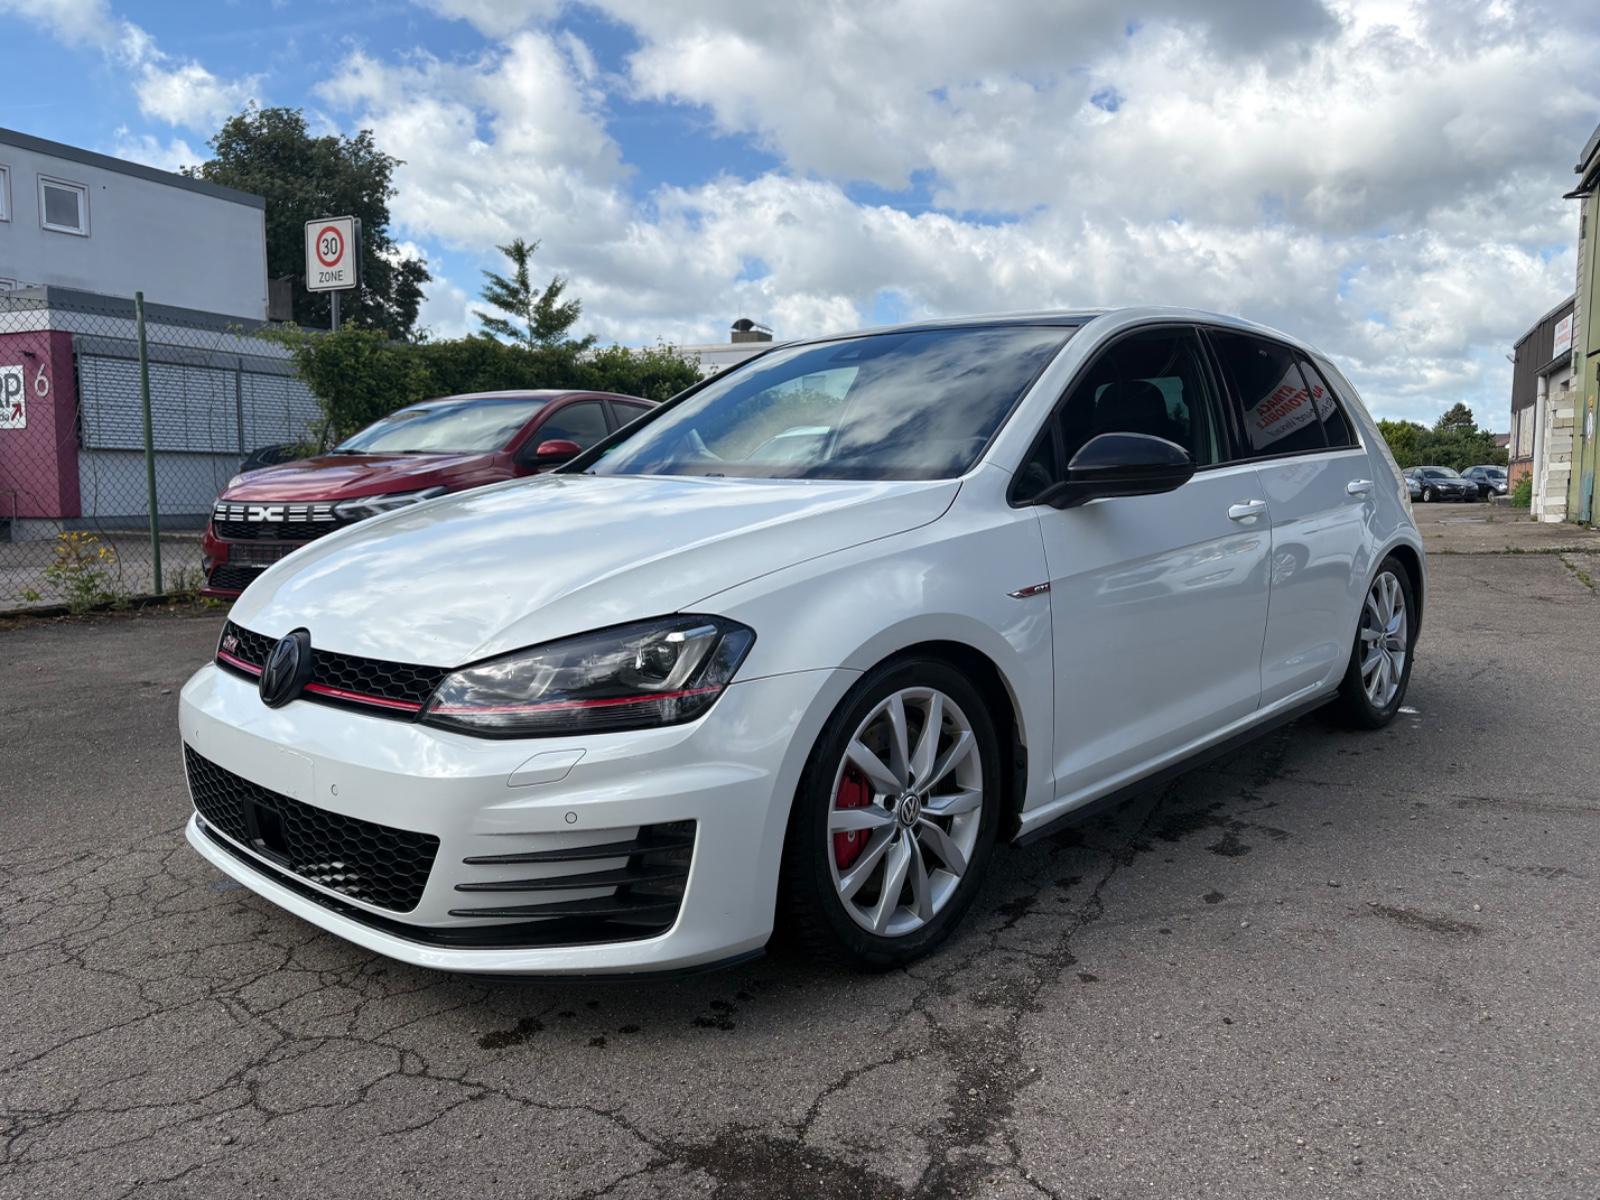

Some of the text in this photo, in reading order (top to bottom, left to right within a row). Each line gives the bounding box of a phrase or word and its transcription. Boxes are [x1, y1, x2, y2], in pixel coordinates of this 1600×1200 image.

[321, 237, 338, 256] 30
[319, 270, 344, 283] ZONE
[34, 362, 49, 398] 6
